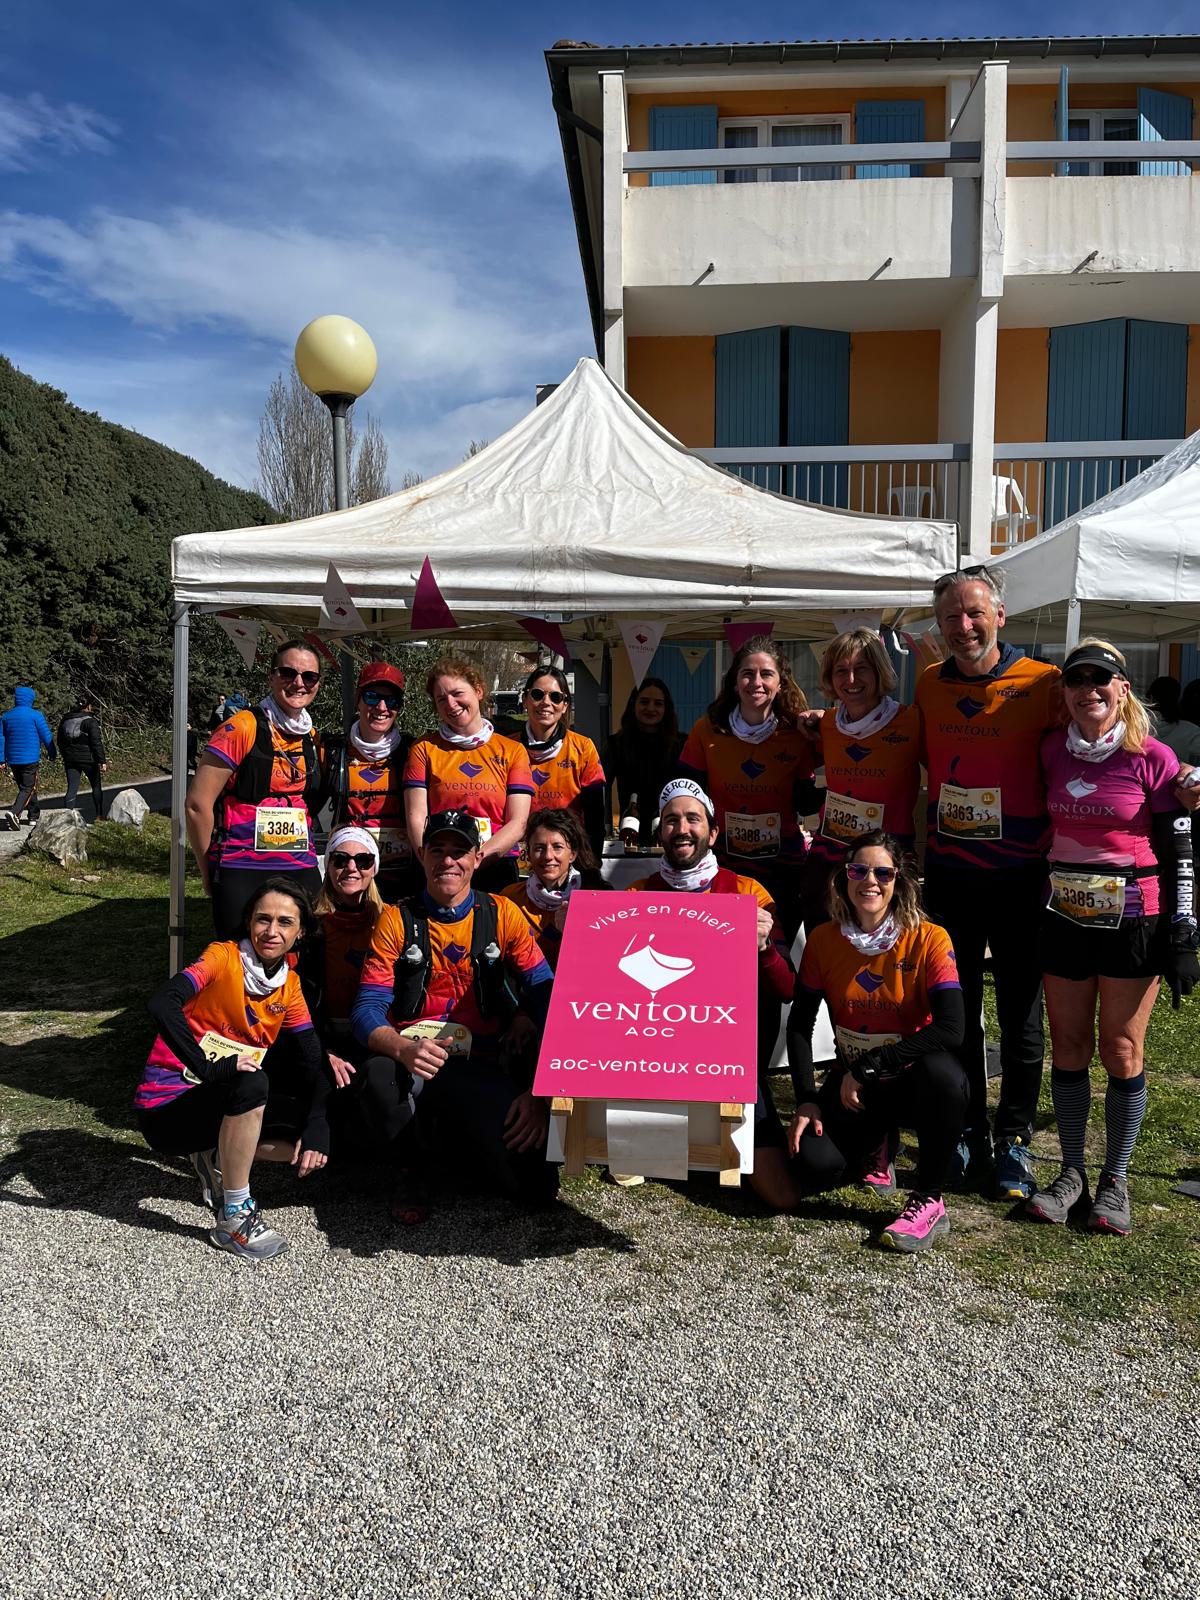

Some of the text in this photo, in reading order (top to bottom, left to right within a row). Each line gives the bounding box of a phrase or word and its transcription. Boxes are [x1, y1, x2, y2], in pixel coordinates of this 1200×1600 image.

[661, 780, 700, 801] MERCIER
[832, 809, 858, 829] 3325
[946, 802, 974, 821] 3363
[267, 821, 295, 836] 3384
[735, 827, 760, 842] 3388
[1062, 887, 1095, 908] 3385
[589, 905, 736, 935] vivez en relief!
[625, 1026, 675, 1038] AOC
[550, 1058, 745, 1076] aoc-ventoux com
